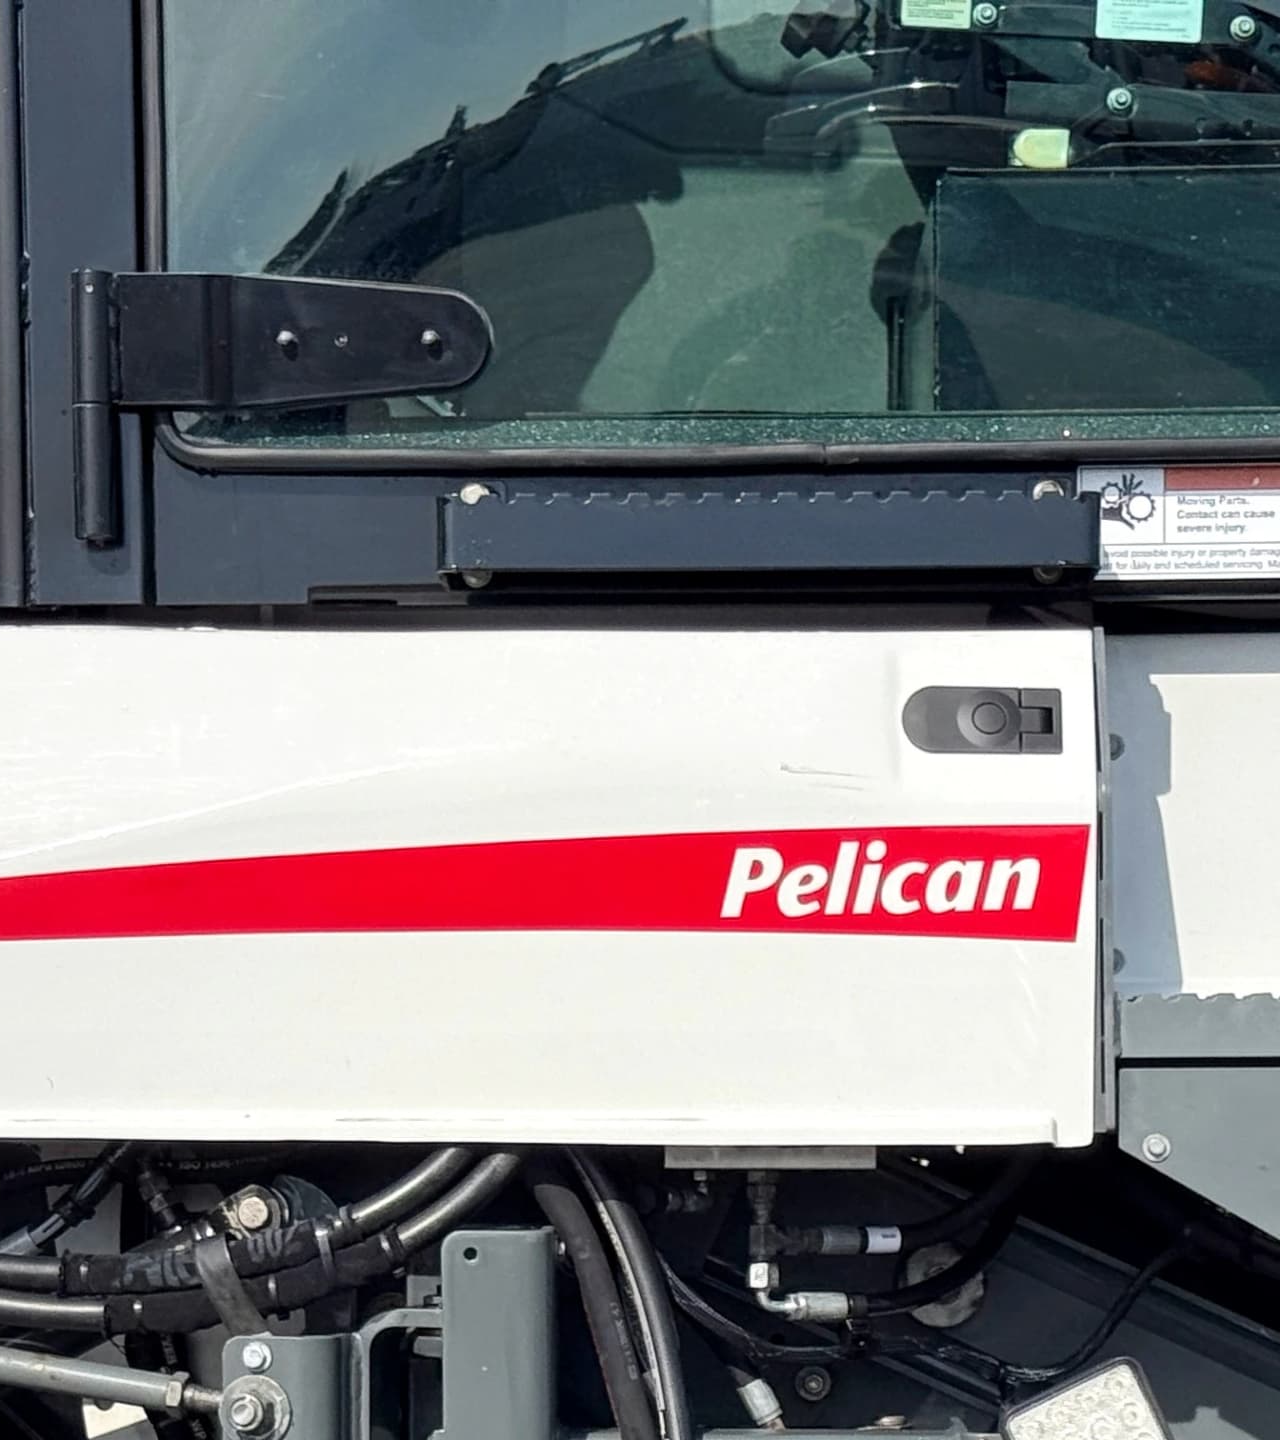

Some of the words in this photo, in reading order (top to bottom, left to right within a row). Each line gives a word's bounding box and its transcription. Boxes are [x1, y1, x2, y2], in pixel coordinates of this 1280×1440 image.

[1177, 510, 1218, 519] Contact
[1221, 511, 1241, 519] can
[1243, 510, 1276, 518] cause
[1177, 523, 1212, 533] severe
[720, 840, 1041, 918] Pelican
